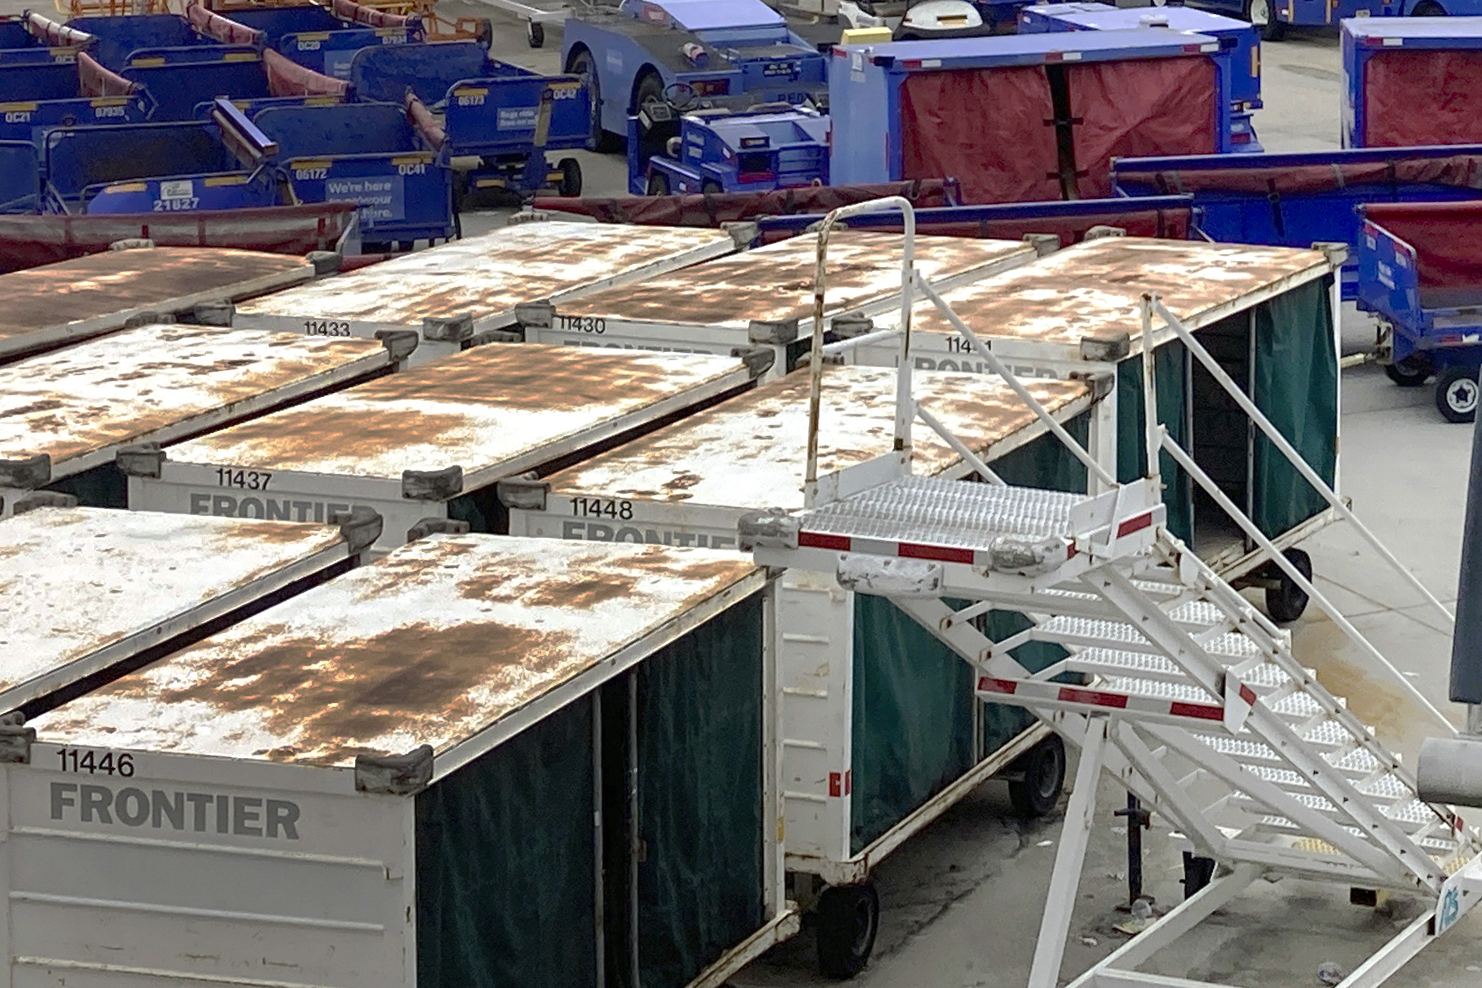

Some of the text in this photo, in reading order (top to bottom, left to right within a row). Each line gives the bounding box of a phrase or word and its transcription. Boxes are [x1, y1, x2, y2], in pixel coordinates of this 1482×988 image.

[328, 180, 392, 194] We're here
[303, 320, 350, 338] 11433
[560, 316, 606, 334] 11430
[945, 336, 992, 354] 1141
[215, 468, 272, 491] 11437
[569, 497, 633, 520] 11448
[57, 748, 135, 778] 11446
[50, 781, 301, 840] FRONTIER
